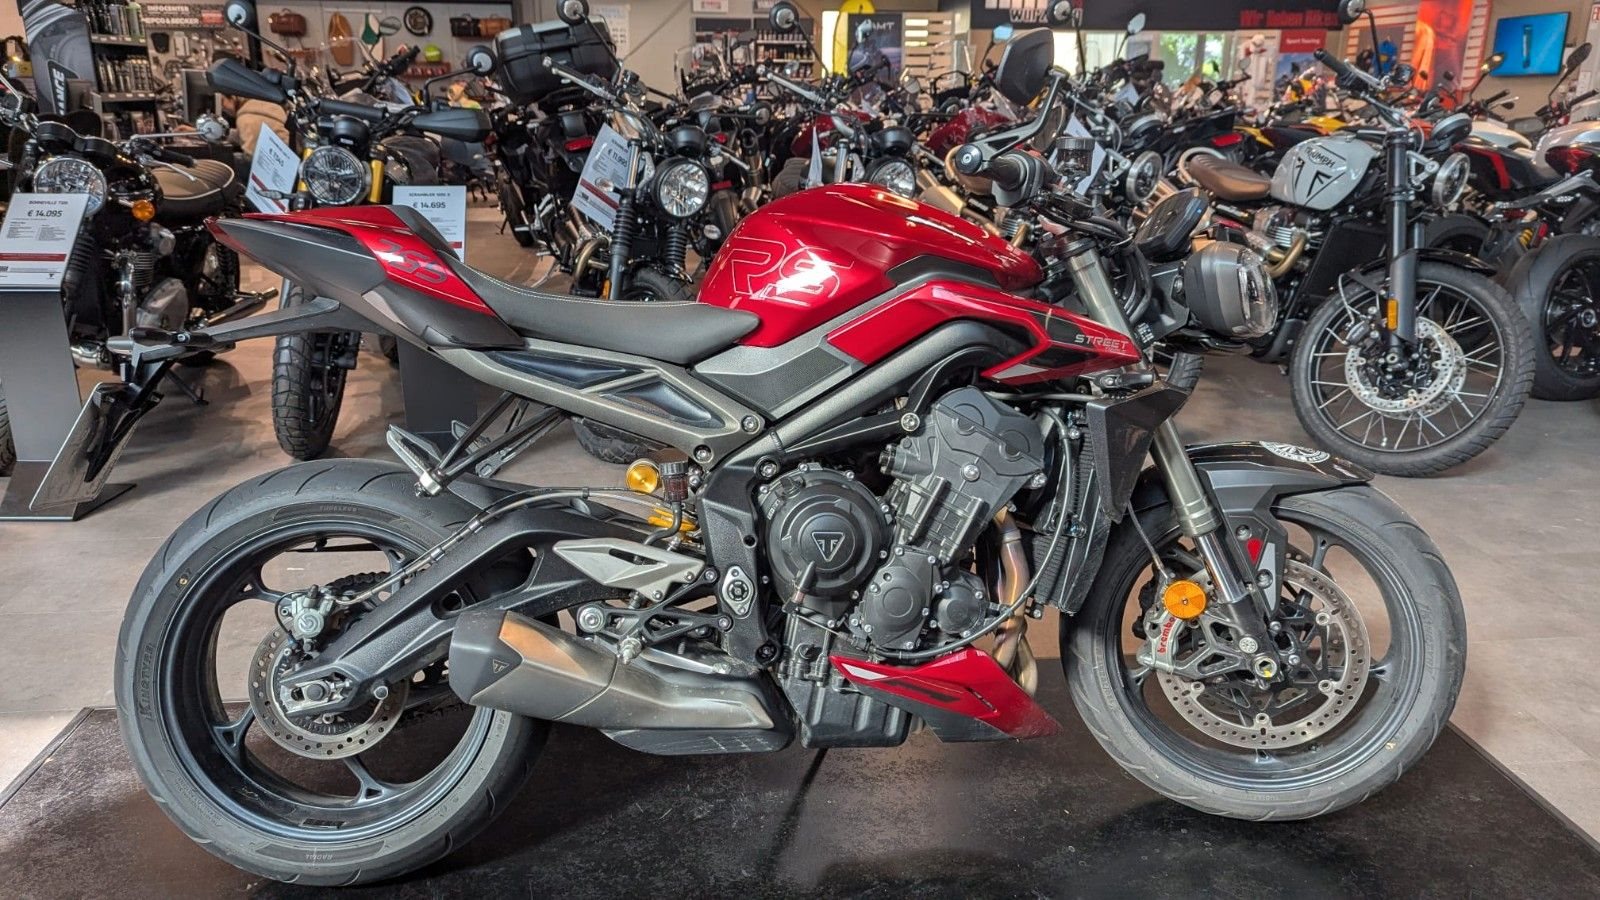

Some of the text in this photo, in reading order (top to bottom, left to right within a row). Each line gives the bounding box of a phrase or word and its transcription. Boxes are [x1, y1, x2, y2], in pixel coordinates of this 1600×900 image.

[1305, 146, 1336, 168] TRIUMPH
[27, 209, 64, 217] € 14.095
[420, 201, 447, 209] 14.695
[1074, 333, 1129, 350] STREET
[1157, 616, 1177, 654] brembo
